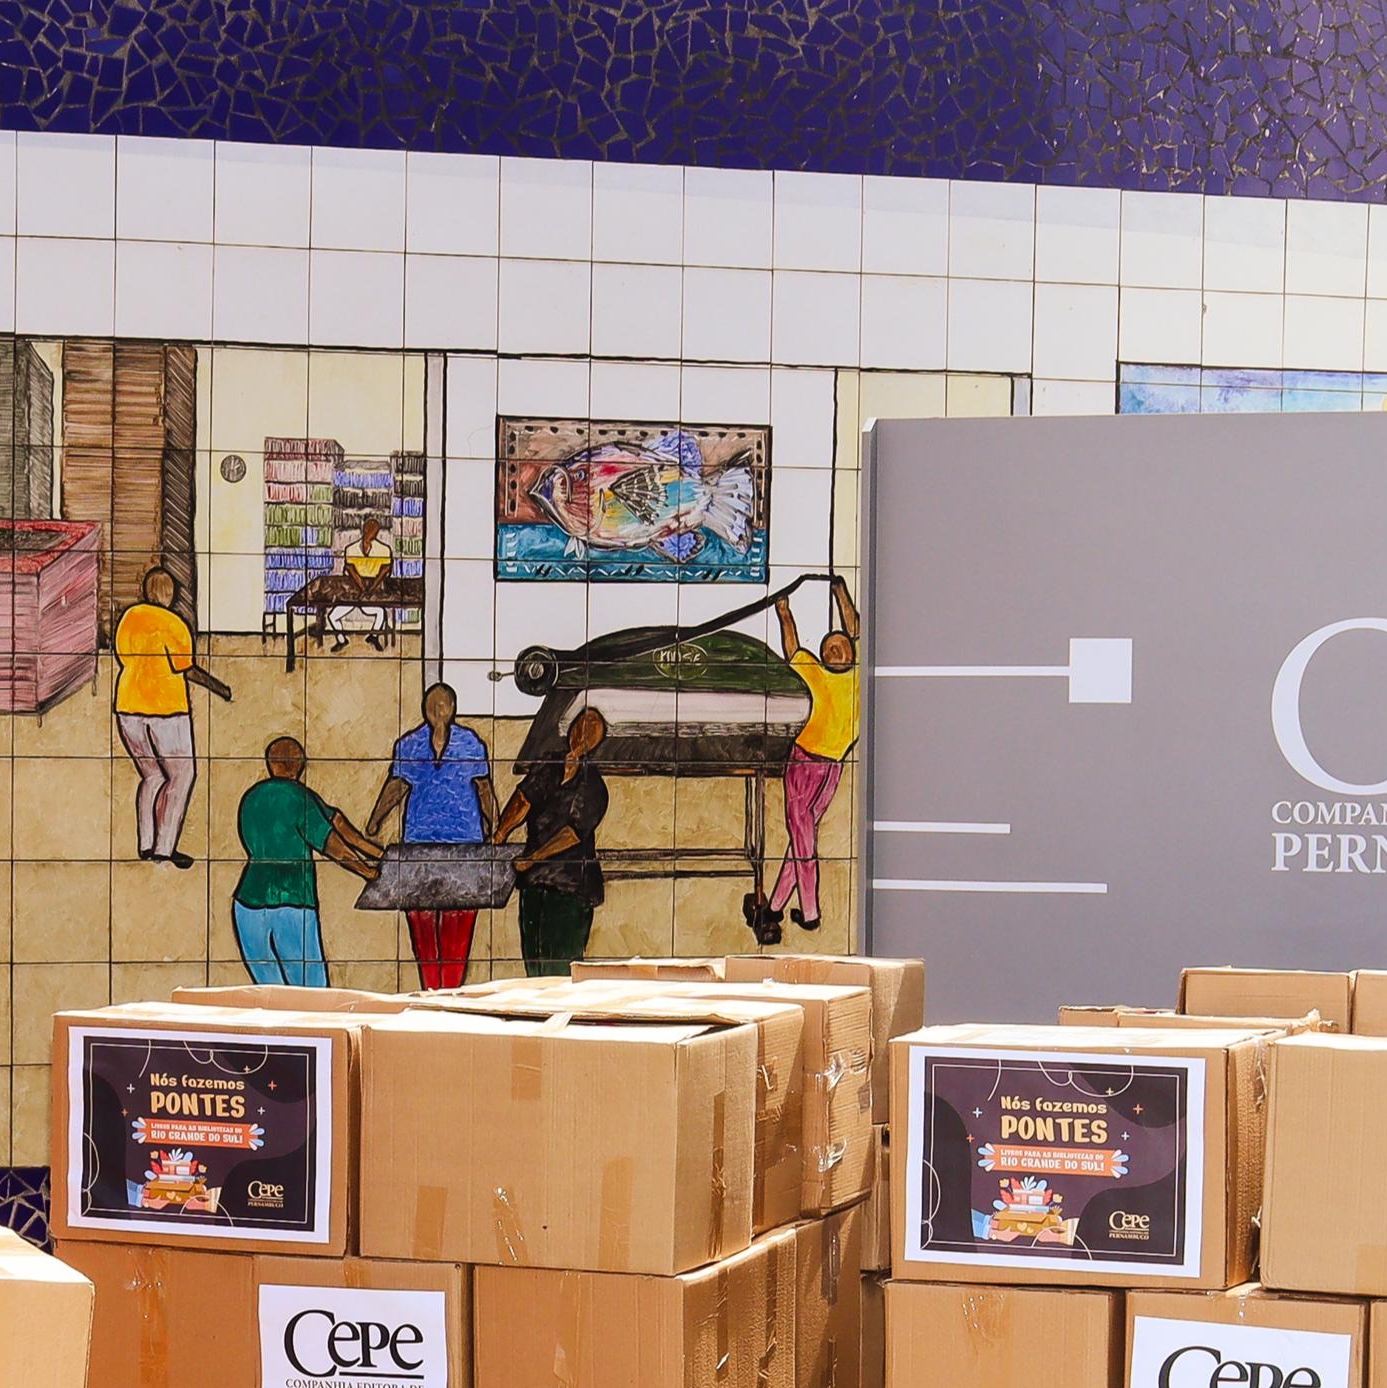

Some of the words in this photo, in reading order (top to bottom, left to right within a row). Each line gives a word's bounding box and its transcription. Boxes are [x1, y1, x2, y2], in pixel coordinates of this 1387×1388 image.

[150, 1072, 177, 1086] Nós
[180, 1074, 245, 1090] fazemos
[150, 1090, 245, 1118] PONTES
[1000, 1095, 1031, 1110] Nós
[1034, 1096, 1107, 1114] fazemos
[150, 1129, 166, 1139] RIO
[168, 1130, 205, 1141] GRANDE
[207, 1132, 220, 1142] DO
[221, 1133, 243, 1144] SUL!
[1000, 1114, 1107, 1144] PONTES
[1000, 1155, 1018, 1166] RIO
[1020, 1156, 1062, 1169] GRANDE
[1064, 1159, 1078, 1170] DO
[1080, 1160, 1105, 1171] SUL!
